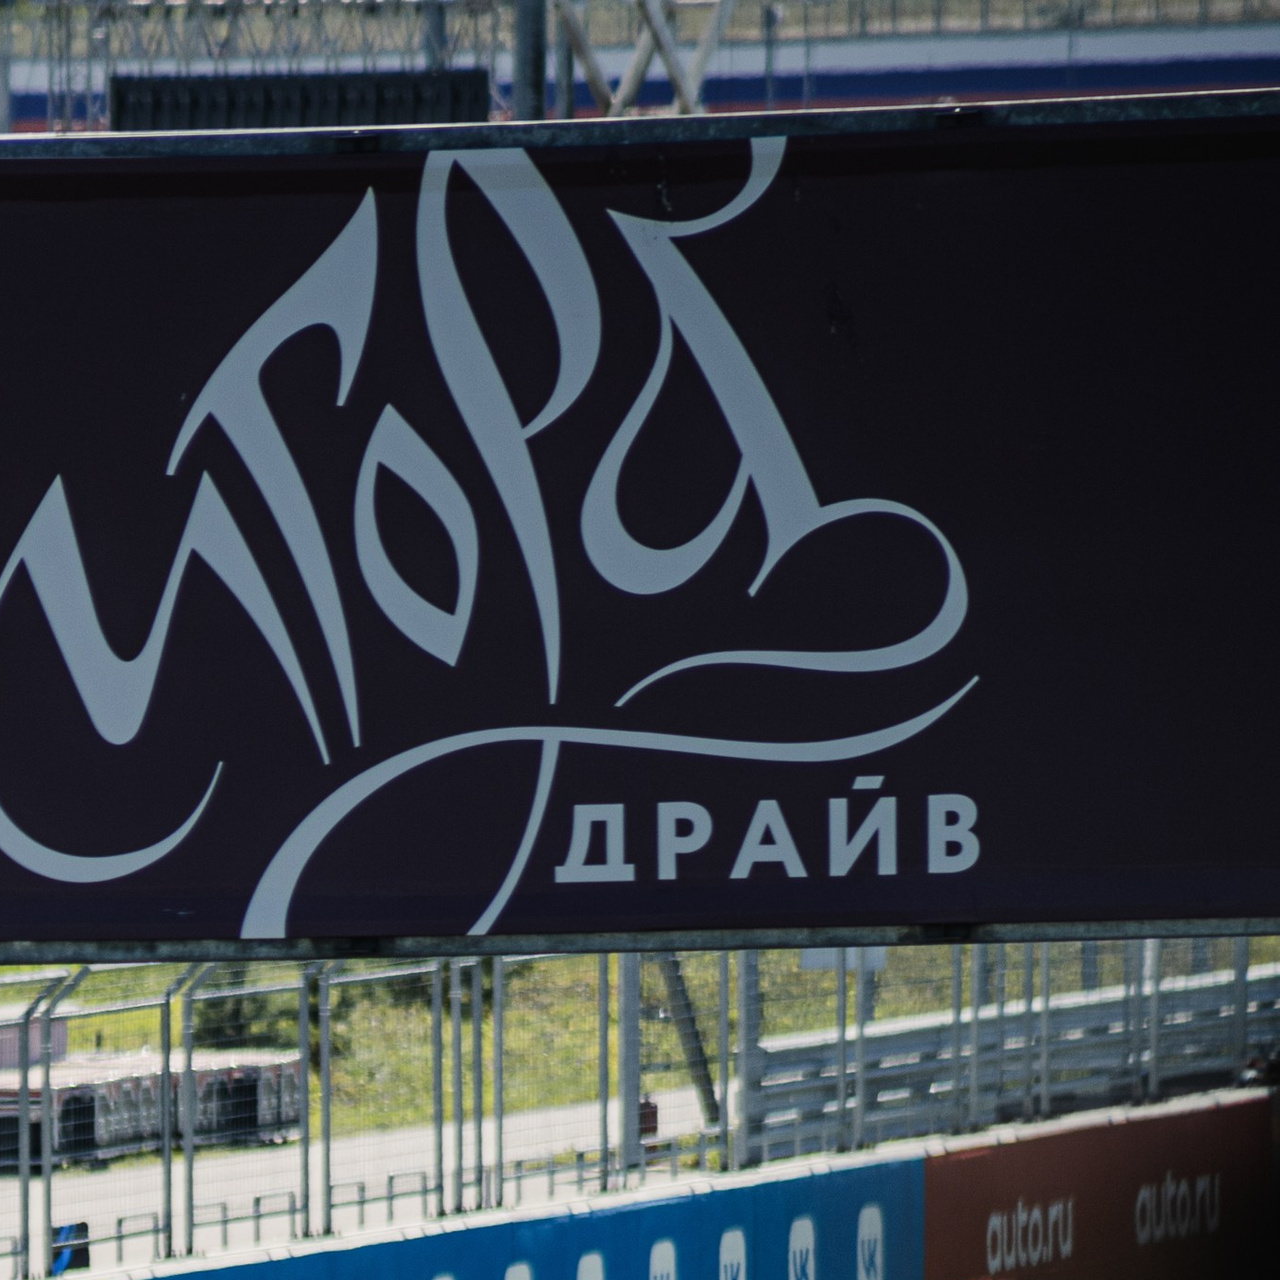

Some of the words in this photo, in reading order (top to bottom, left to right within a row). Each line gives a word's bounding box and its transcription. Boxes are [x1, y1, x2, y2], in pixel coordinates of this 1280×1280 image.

[554, 774, 981, 884] ДРАЙВ
[861, 1235, 878, 1280] VK
[986, 1197, 1073, 1275] auto.ru
